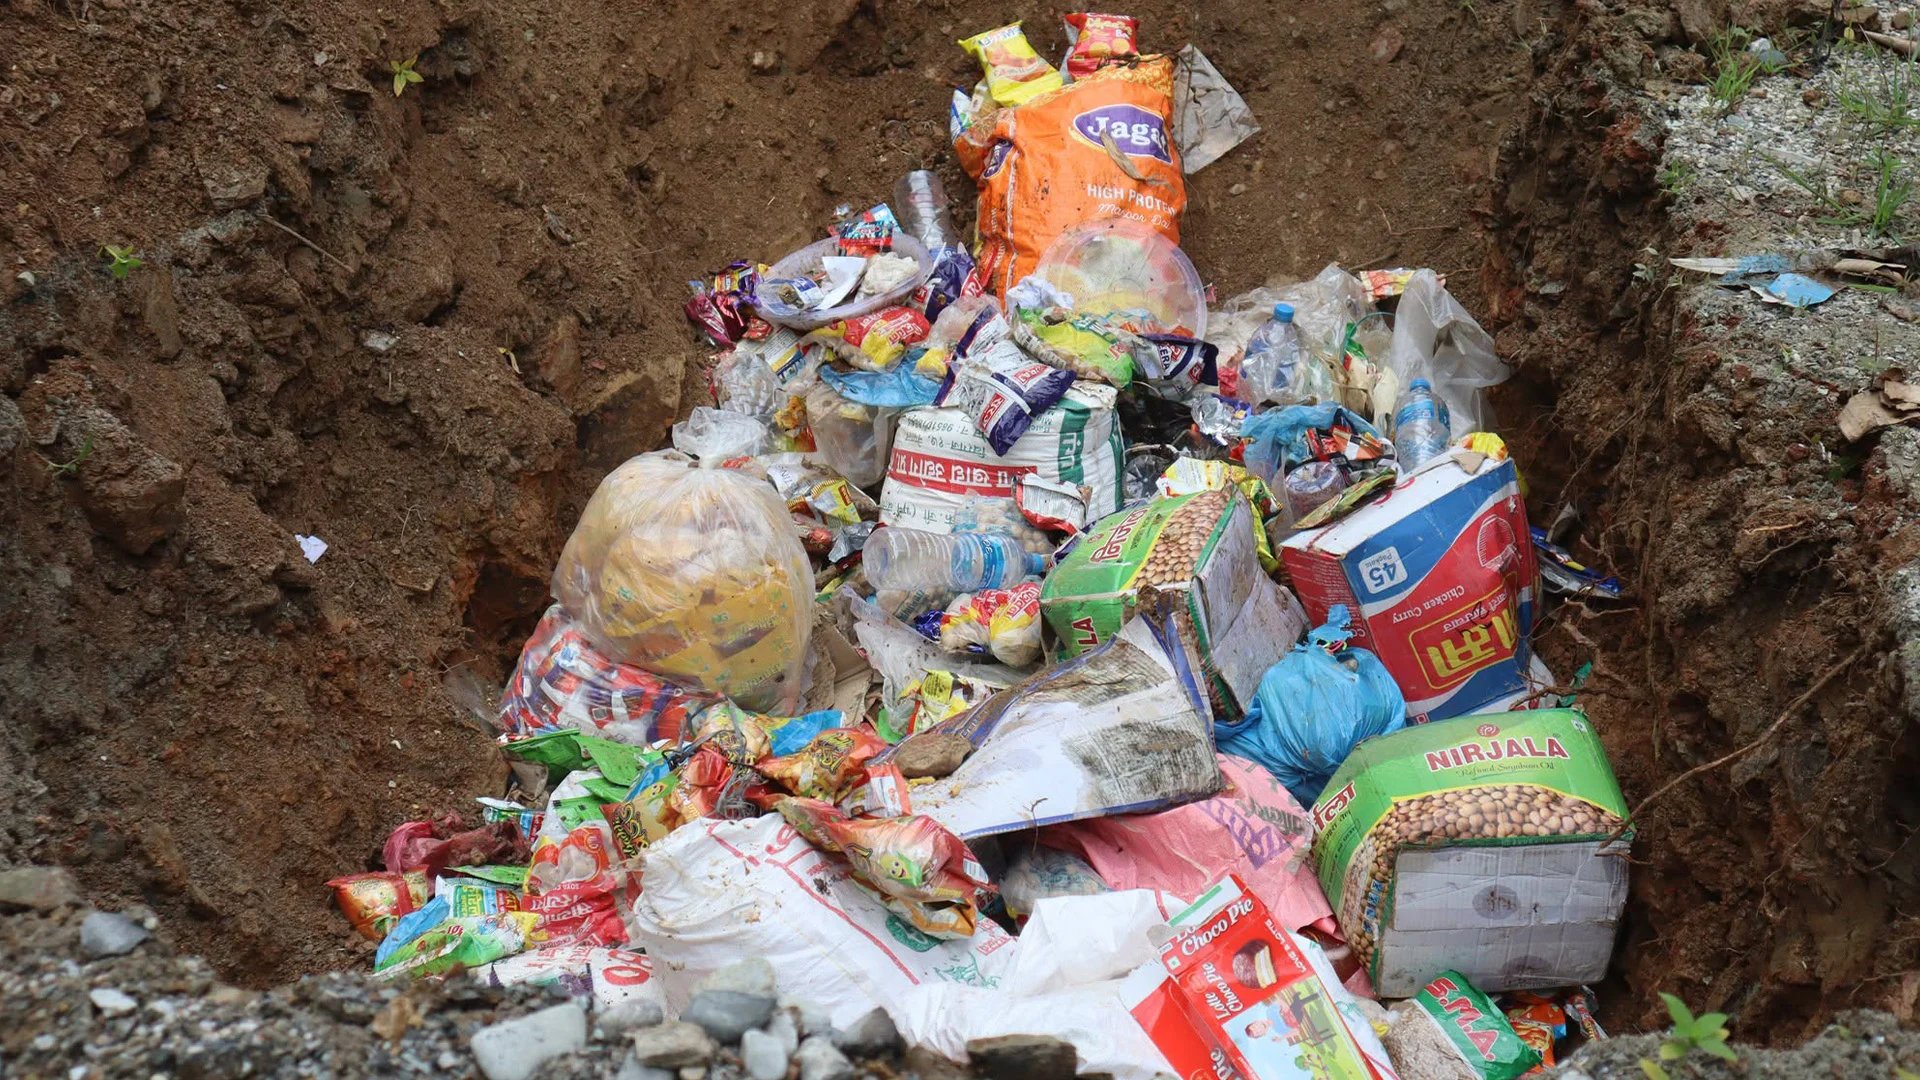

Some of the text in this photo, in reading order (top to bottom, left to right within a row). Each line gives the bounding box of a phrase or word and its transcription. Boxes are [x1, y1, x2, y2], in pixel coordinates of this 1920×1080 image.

[1086, 183, 1177, 216] HIGH PROTEIN
[1368, 561, 1398, 586] 45
[1391, 585, 1465, 624] Chicken Curry
[1071, 616, 1099, 653] LA
[1424, 736, 1570, 773] NIRJALA
[1180, 919, 1229, 956] Choco
[1227, 897, 1254, 927] Pie
[1264, 918, 1285, 945] LOTTE
[1286, 950, 1308, 974] LOVE
[1202, 961, 1244, 1013] Choco Pie
[1205, 992, 1231, 1021] Lotte
[1423, 976, 1501, 1061] S.M.A.
